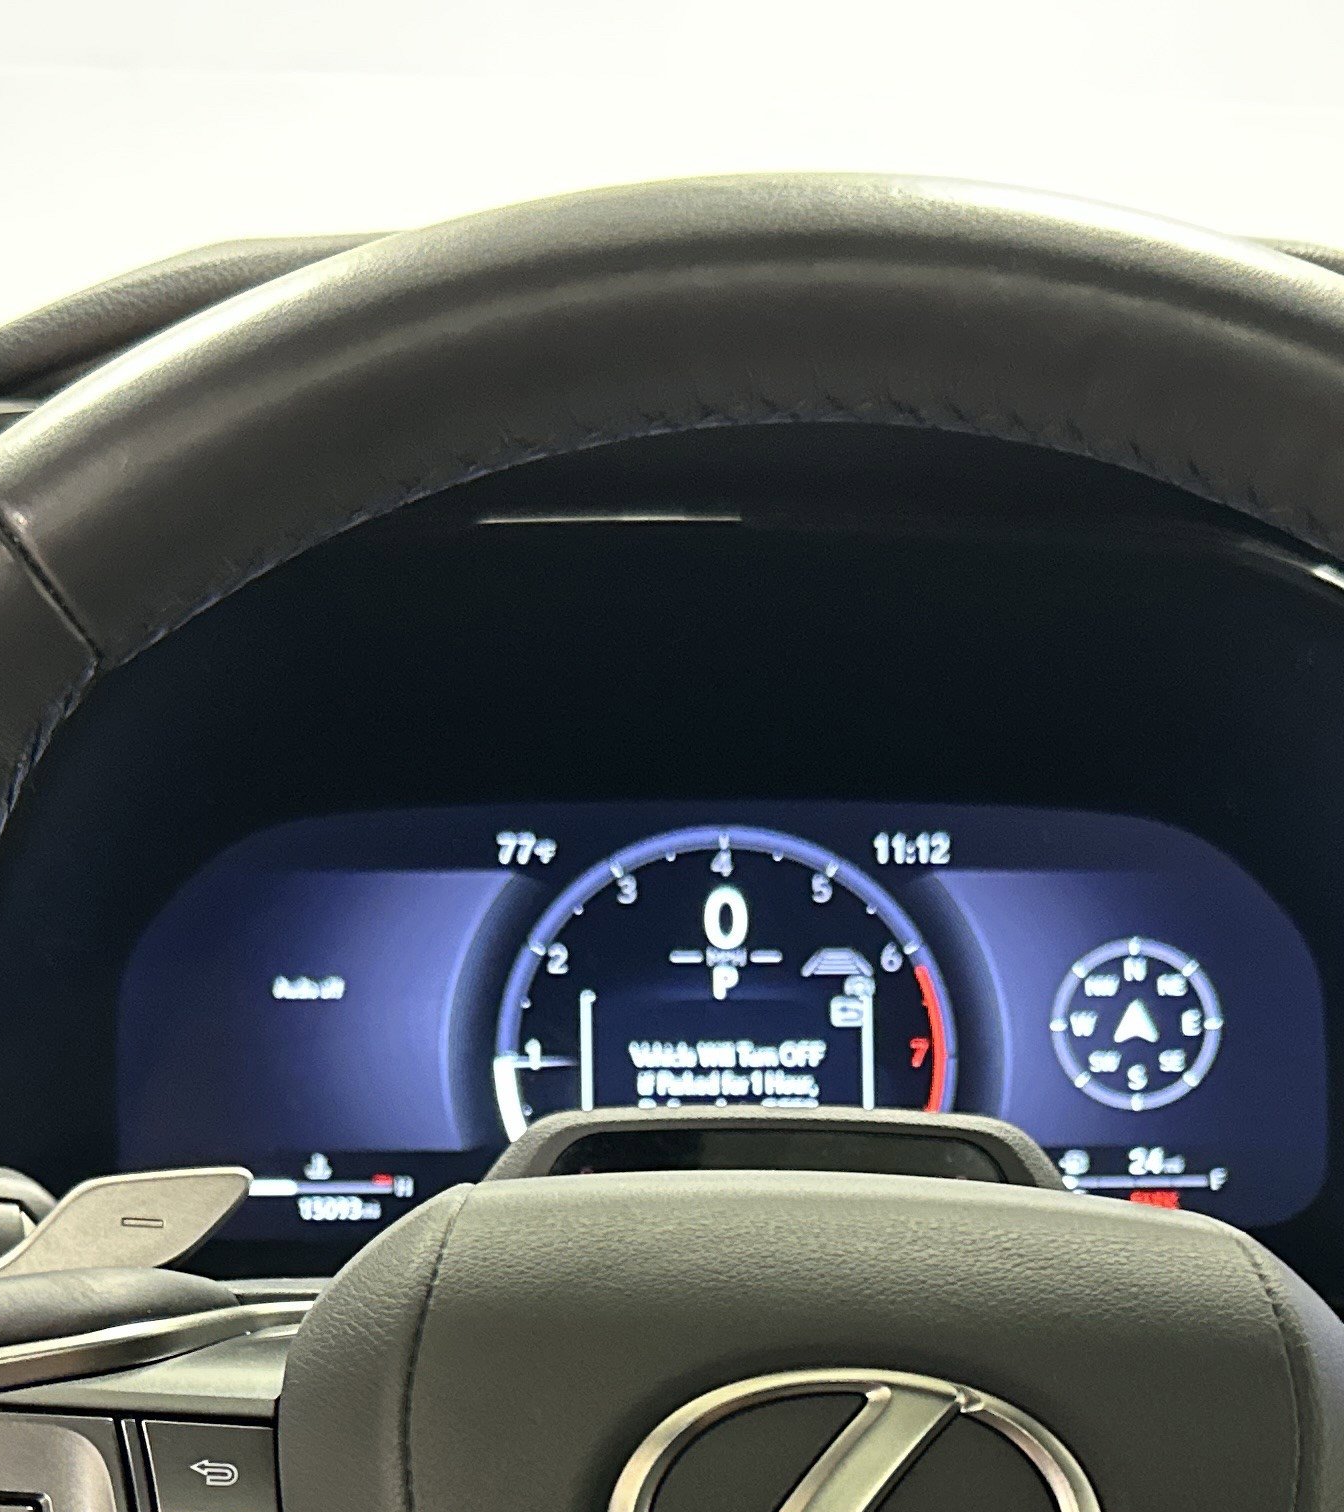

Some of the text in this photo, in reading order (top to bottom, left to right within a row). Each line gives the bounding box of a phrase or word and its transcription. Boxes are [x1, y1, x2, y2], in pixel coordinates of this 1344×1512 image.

[873, 831, 951, 865] 11:12
[710, 852, 733, 877] 4
[616, 873, 638, 905] 3
[811, 873, 833, 903] 5
[703, 886, 748, 949] 0
[546, 943, 570, 974] 2
[880, 944, 904, 972] 6
[1123, 957, 1147, 981] N
[712, 965, 739, 1000] P
[1069, 1010, 1098, 1037] W
[1181, 1008, 1204, 1036] E
[525, 1040, 542, 1069] 1
[910, 1038, 930, 1068] 7
[1127, 1064, 1148, 1090] S
[1128, 1147, 1164, 1176] 24
